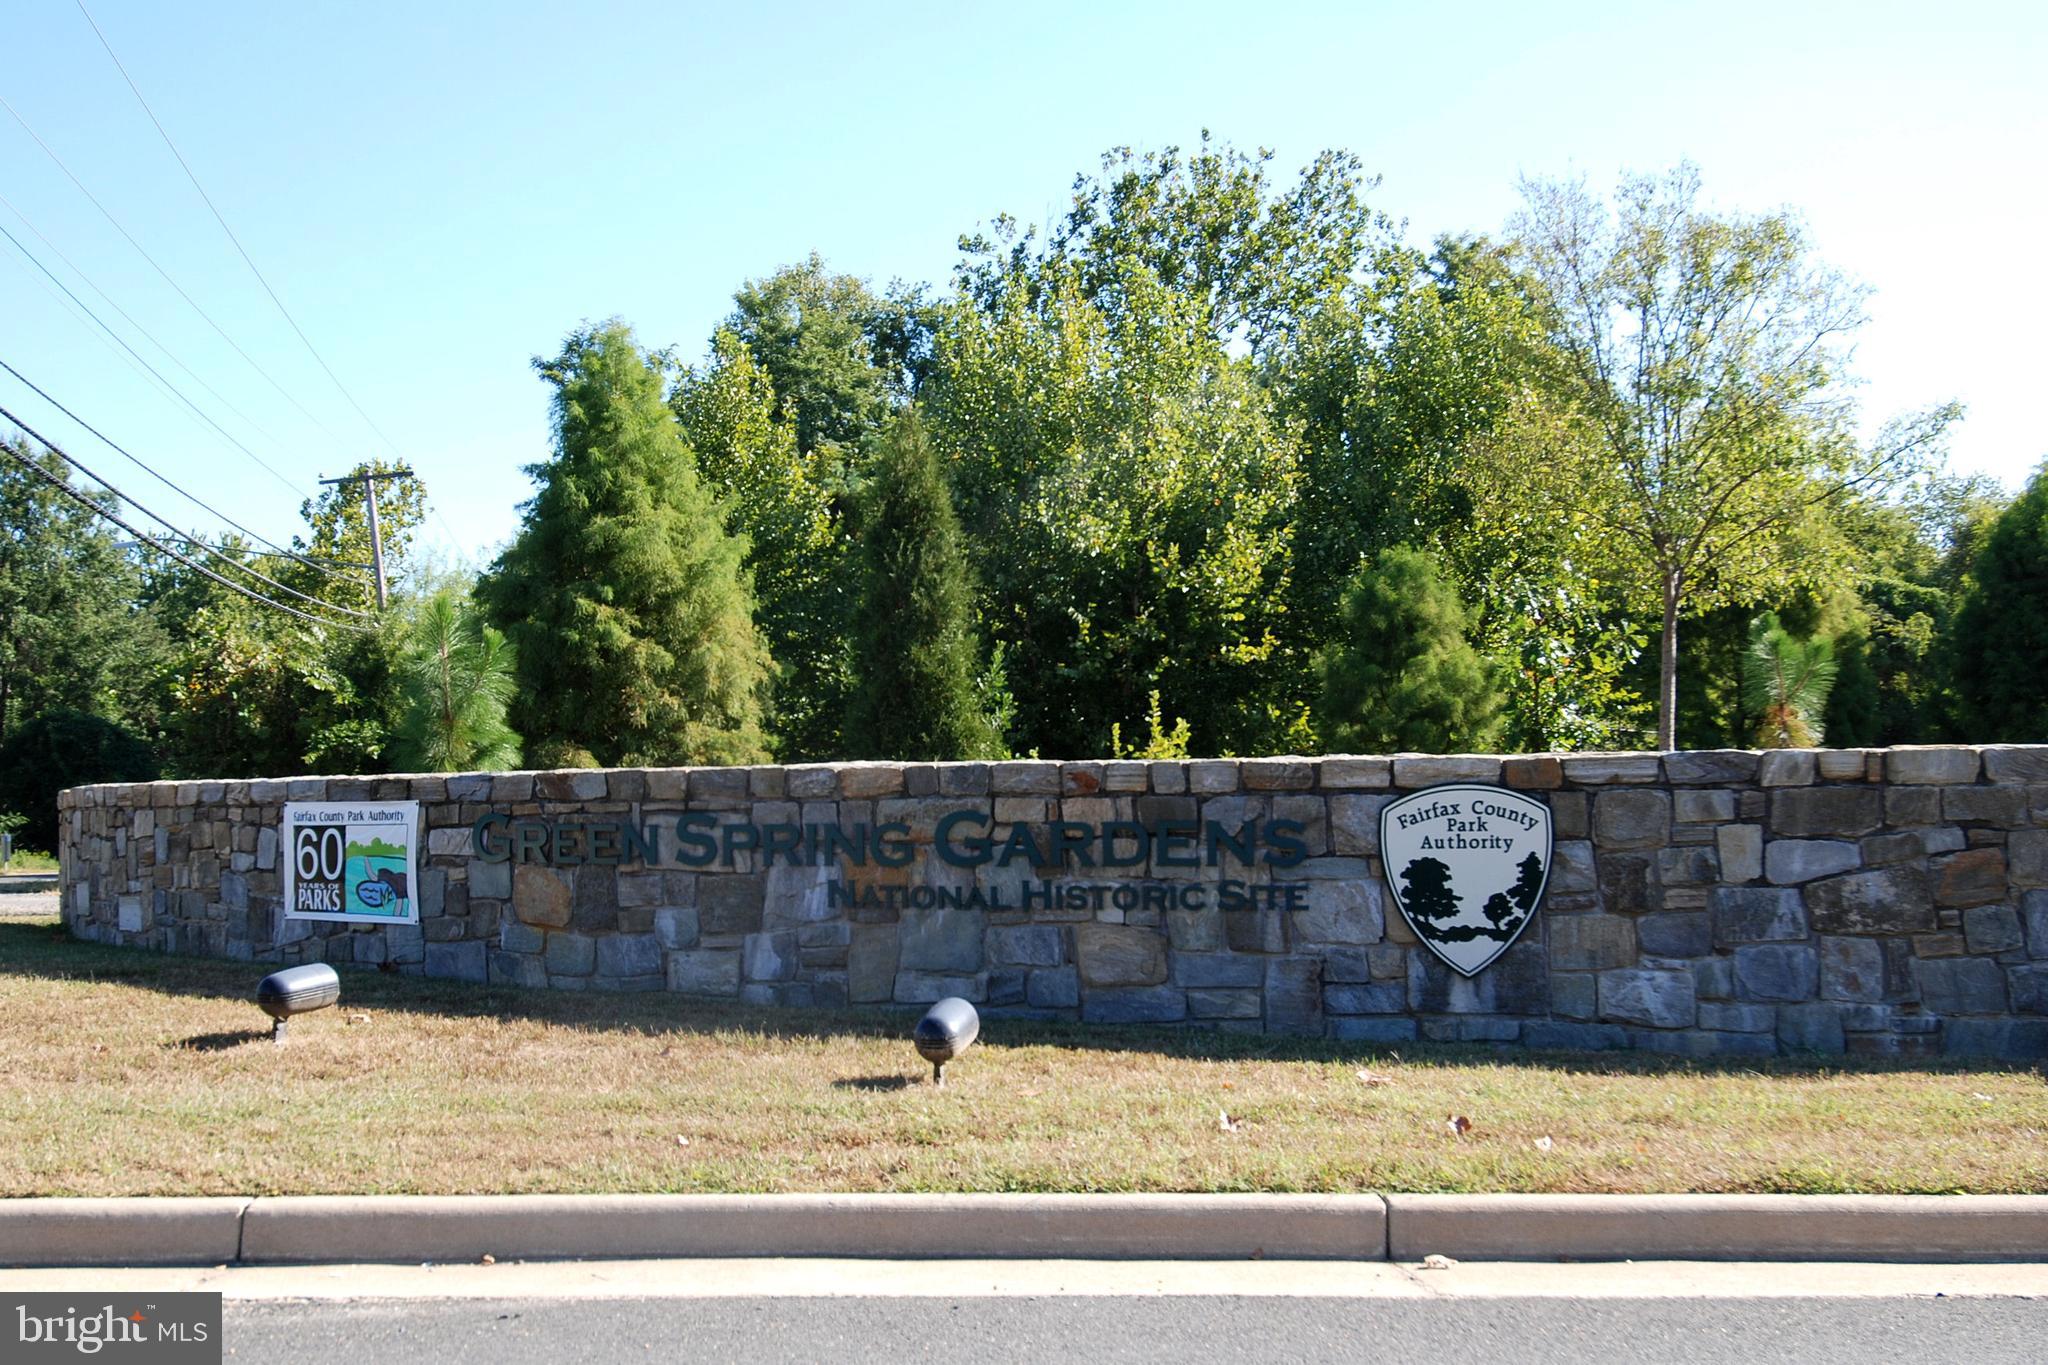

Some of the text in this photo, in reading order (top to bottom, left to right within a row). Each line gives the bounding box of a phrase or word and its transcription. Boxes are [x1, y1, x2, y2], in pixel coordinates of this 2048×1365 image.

[294, 810, 404, 822] Fairfax County Park Authority
[1396, 800, 1540, 832] Fairfax County
[1447, 816, 1488, 832] Park
[471, 809, 1308, 868] GREEN SPRING GARDENS
[1420, 834, 1514, 853] Authority
[296, 827, 343, 881] 60
[298, 889, 340, 911] PARKS
[827, 878, 1310, 911] NATIONAL HISTORIC SITE
